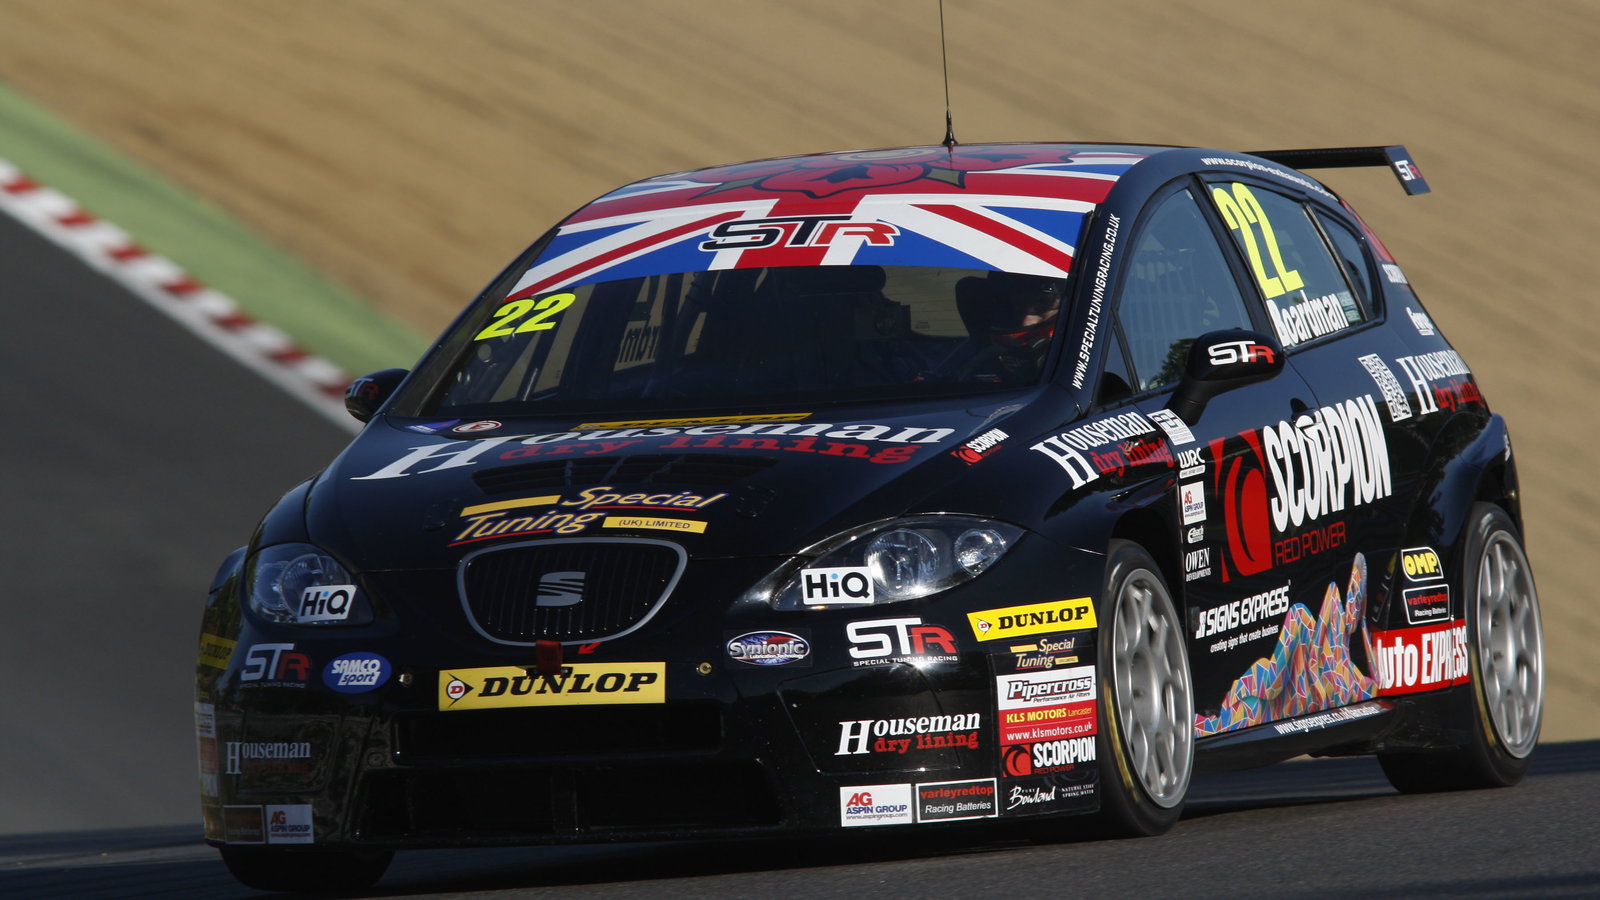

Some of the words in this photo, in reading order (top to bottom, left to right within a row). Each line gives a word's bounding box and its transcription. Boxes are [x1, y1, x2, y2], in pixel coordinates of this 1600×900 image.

[1395, 160, 1424, 180] STR
[699, 215, 902, 252] STR
[1212, 182, 1304, 299] 22
[1072, 213, 1120, 390] WWW.SPECIALTUNINGRACING.CO.UK
[475, 293, 576, 341] 22
[1266, 290, 1349, 347] Boardman
[1208, 340, 1275, 365] STR
[350, 422, 956, 480] Houseman
[499, 439, 646, 461] dry
[660, 435, 924, 464] lining
[1030, 411, 1156, 490] Houseman
[1177, 448, 1205, 468] WRC
[1091, 450, 1125, 476] dry
[1264, 394, 1392, 533] SCORPION
[561, 486, 728, 511] Special
[454, 509, 605, 540] Tuning
[618, 518, 642, 529] (UK)
[645, 519, 691, 530] LIMITED
[1275, 537, 1300, 566] RED
[1303, 521, 1347, 557] POWER
[1185, 548, 1210, 572] OWEN
[1404, 552, 1437, 575] OMP
[806, 573, 871, 600] HiQ
[301, 589, 349, 616] HiQ
[1206, 601, 1240, 636] SIGNS
[1241, 585, 1289, 625] EXPRESS
[998, 606, 1089, 630] DUNLOP
[730, 640, 804, 658] Synionic
[846, 617, 957, 659] STR
[1039, 637, 1075, 654] Special
[1210, 639, 1227, 653] creating
[1228, 636, 1238, 649] signs
[1239, 633, 1248, 644] that
[1248, 630, 1261, 642] create
[1262, 624, 1279, 637] business
[240, 643, 310, 681] STR
[331, 659, 380, 674] SAMCO
[854, 659, 890, 667] SPECIAL
[1016, 653, 1054, 669] Tuning
[1421, 626, 1468, 684] EXPRESS
[341, 671, 375, 685] sport
[478, 672, 658, 698] DUNLOP
[1007, 676, 1092, 702] Pipercross
[1033, 695, 1067, 703] Performance
[1006, 713, 1025, 723] KLS
[1027, 708, 1067, 721] MOTORS
[1068, 707, 1092, 717] Lancaster
[834, 712, 981, 755] Houseman
[874, 737, 912, 754] dry
[917, 732, 979, 750] lining
[1007, 722, 1092, 741] www.klsmotors.co.uk
[225, 742, 311, 775] Houseman
[1033, 736, 1096, 768] SCORPION
[846, 792, 872, 806] AG
[920, 786, 994, 799] varleyredtop
[1007, 784, 1056, 810] Bowland
[271, 810, 286, 824] AG
[846, 807, 873, 815] ASPIN
[877, 805, 907, 814] GROUP
[925, 804, 954, 814] Racing
[956, 801, 991, 812] Batteries
